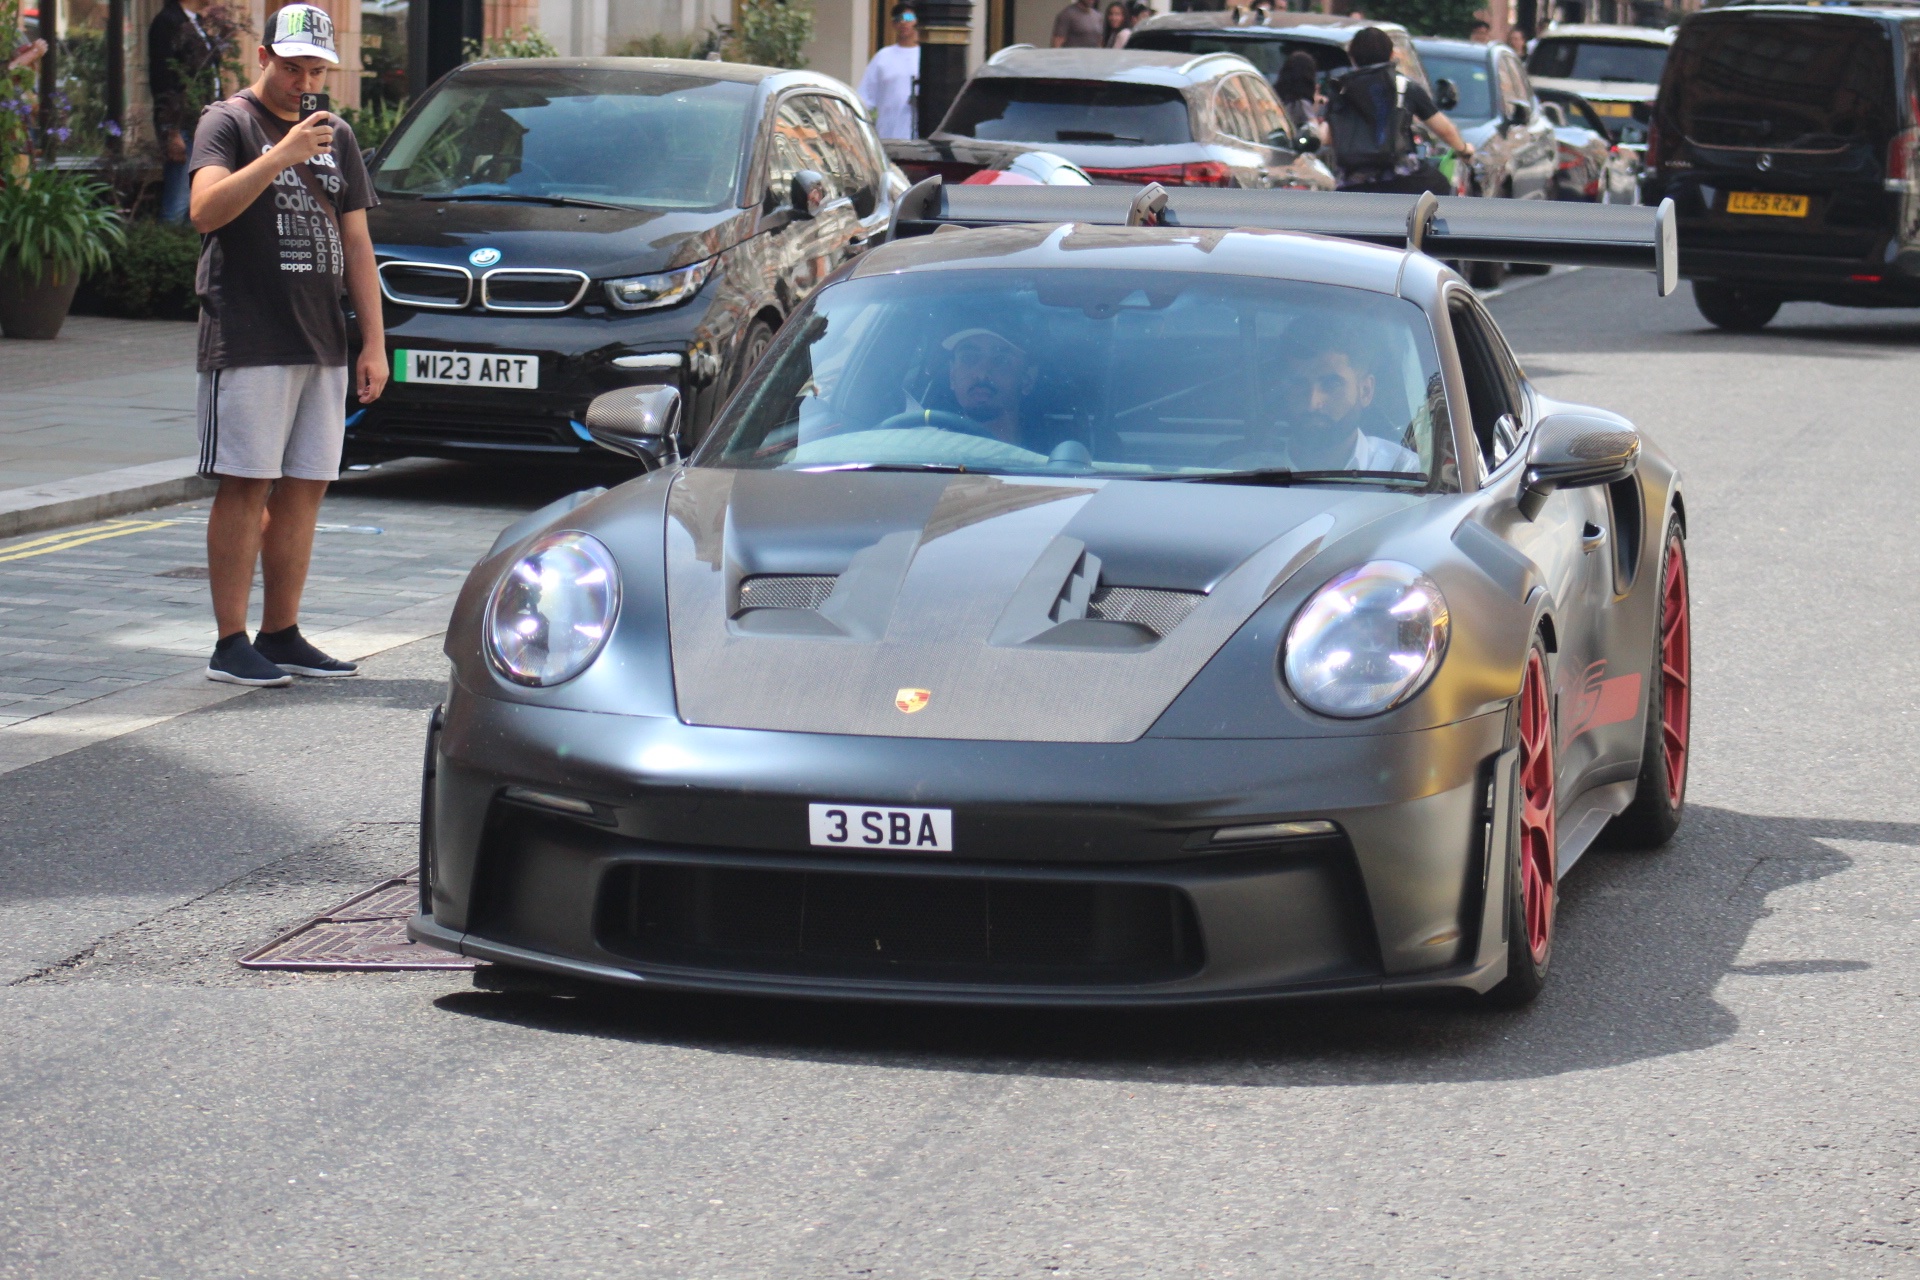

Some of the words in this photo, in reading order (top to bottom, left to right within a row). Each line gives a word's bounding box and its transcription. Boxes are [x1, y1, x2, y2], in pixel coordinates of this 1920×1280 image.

[280, 251, 312, 260] adidas
[310, 215, 327, 273] adidas
[280, 263, 312, 272] adidas
[479, 358, 528, 383] ART
[825, 809, 848, 843] 3
[861, 810, 938, 847] SBA
